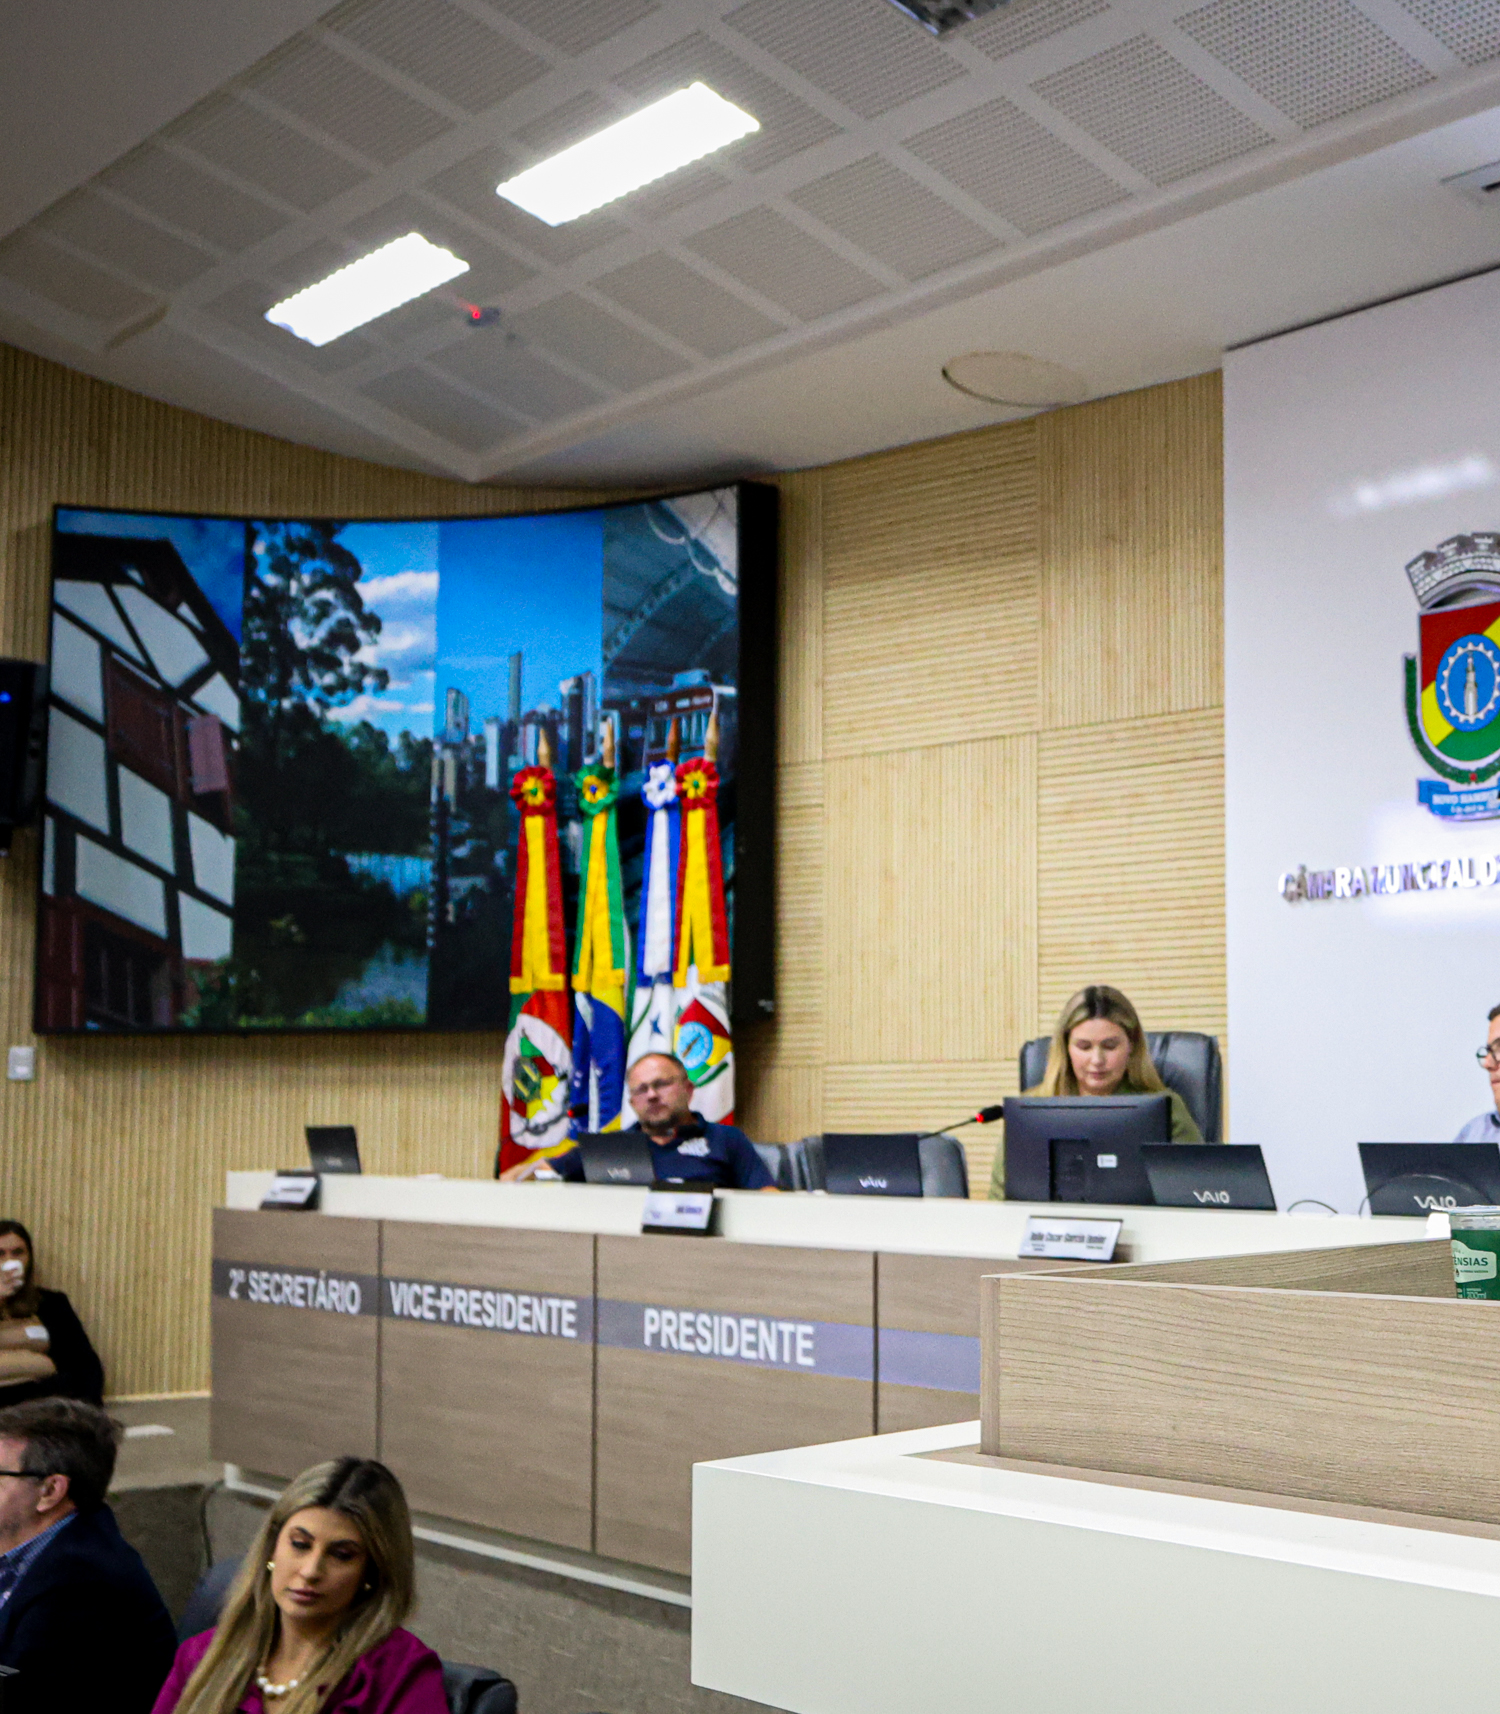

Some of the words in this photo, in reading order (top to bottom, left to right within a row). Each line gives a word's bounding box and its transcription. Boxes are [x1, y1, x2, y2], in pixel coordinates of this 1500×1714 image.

[1192, 1190, 1230, 1203] VAIO
[1413, 1195, 1457, 1209] VAIO
[248, 1270, 362, 1315] SECRETÁRIO
[389, 1280, 578, 1338] VICE-PRESIDENTE
[643, 1307, 816, 1367] PRESIDENTE
